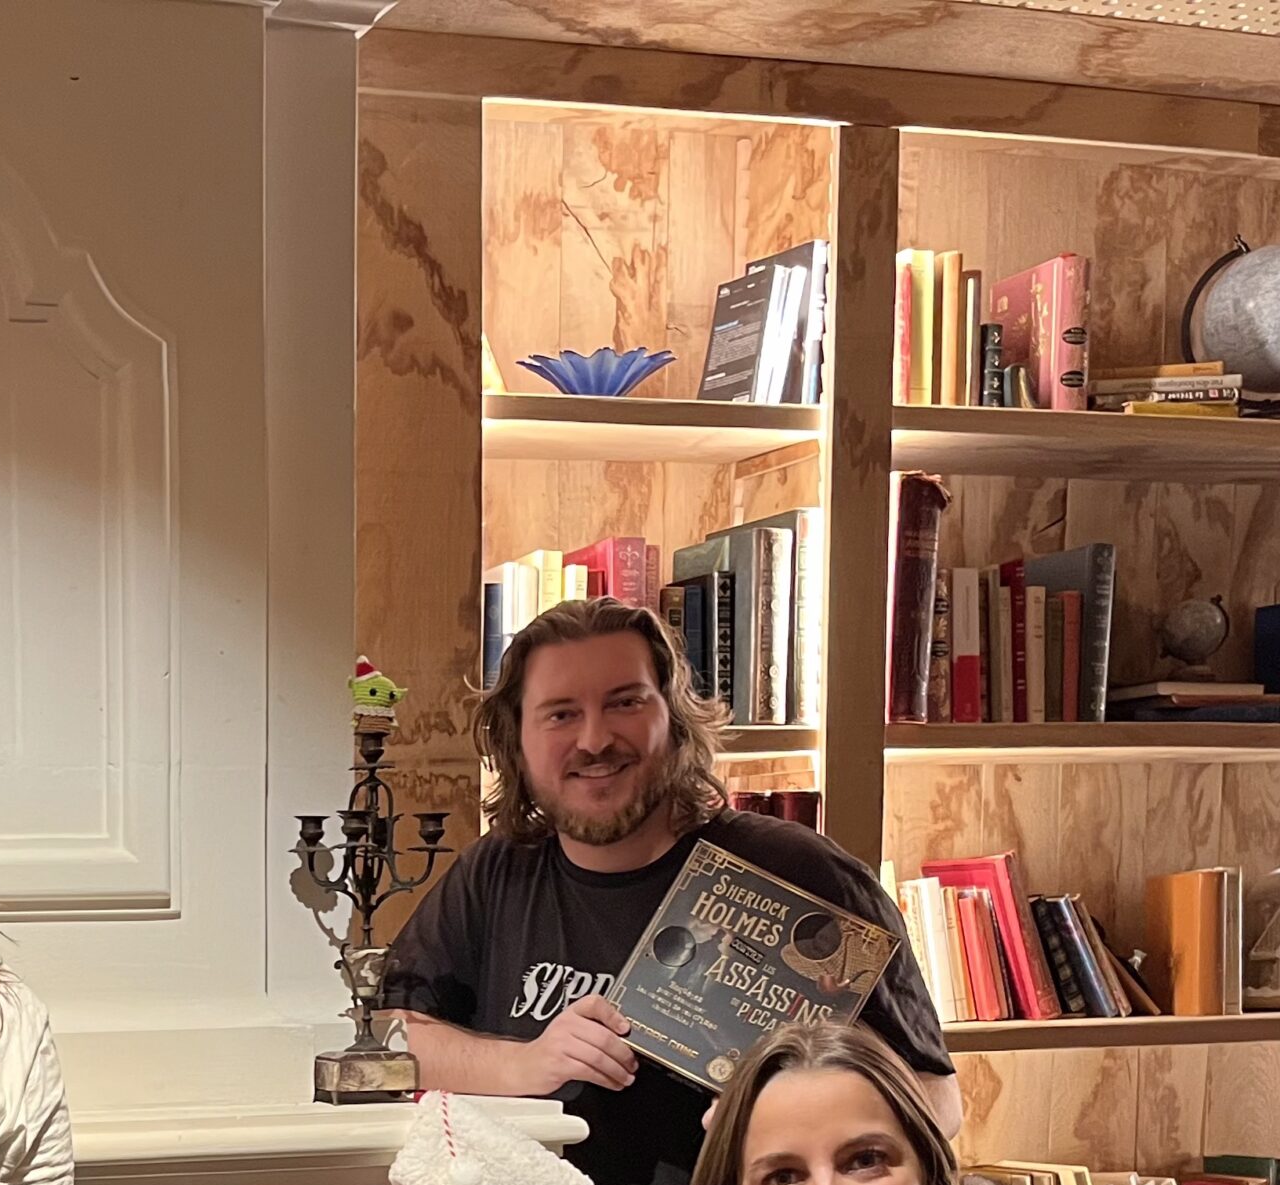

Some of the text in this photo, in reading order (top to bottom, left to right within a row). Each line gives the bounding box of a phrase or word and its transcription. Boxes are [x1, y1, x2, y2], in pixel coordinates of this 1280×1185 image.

[690, 891, 784, 948] HOLMES
[712, 874, 791, 921] SHERLOCK
[704, 955, 835, 1029] ASSASSINS
[762, 963, 777, 976] LES
[736, 1002, 779, 1032] PICCA
